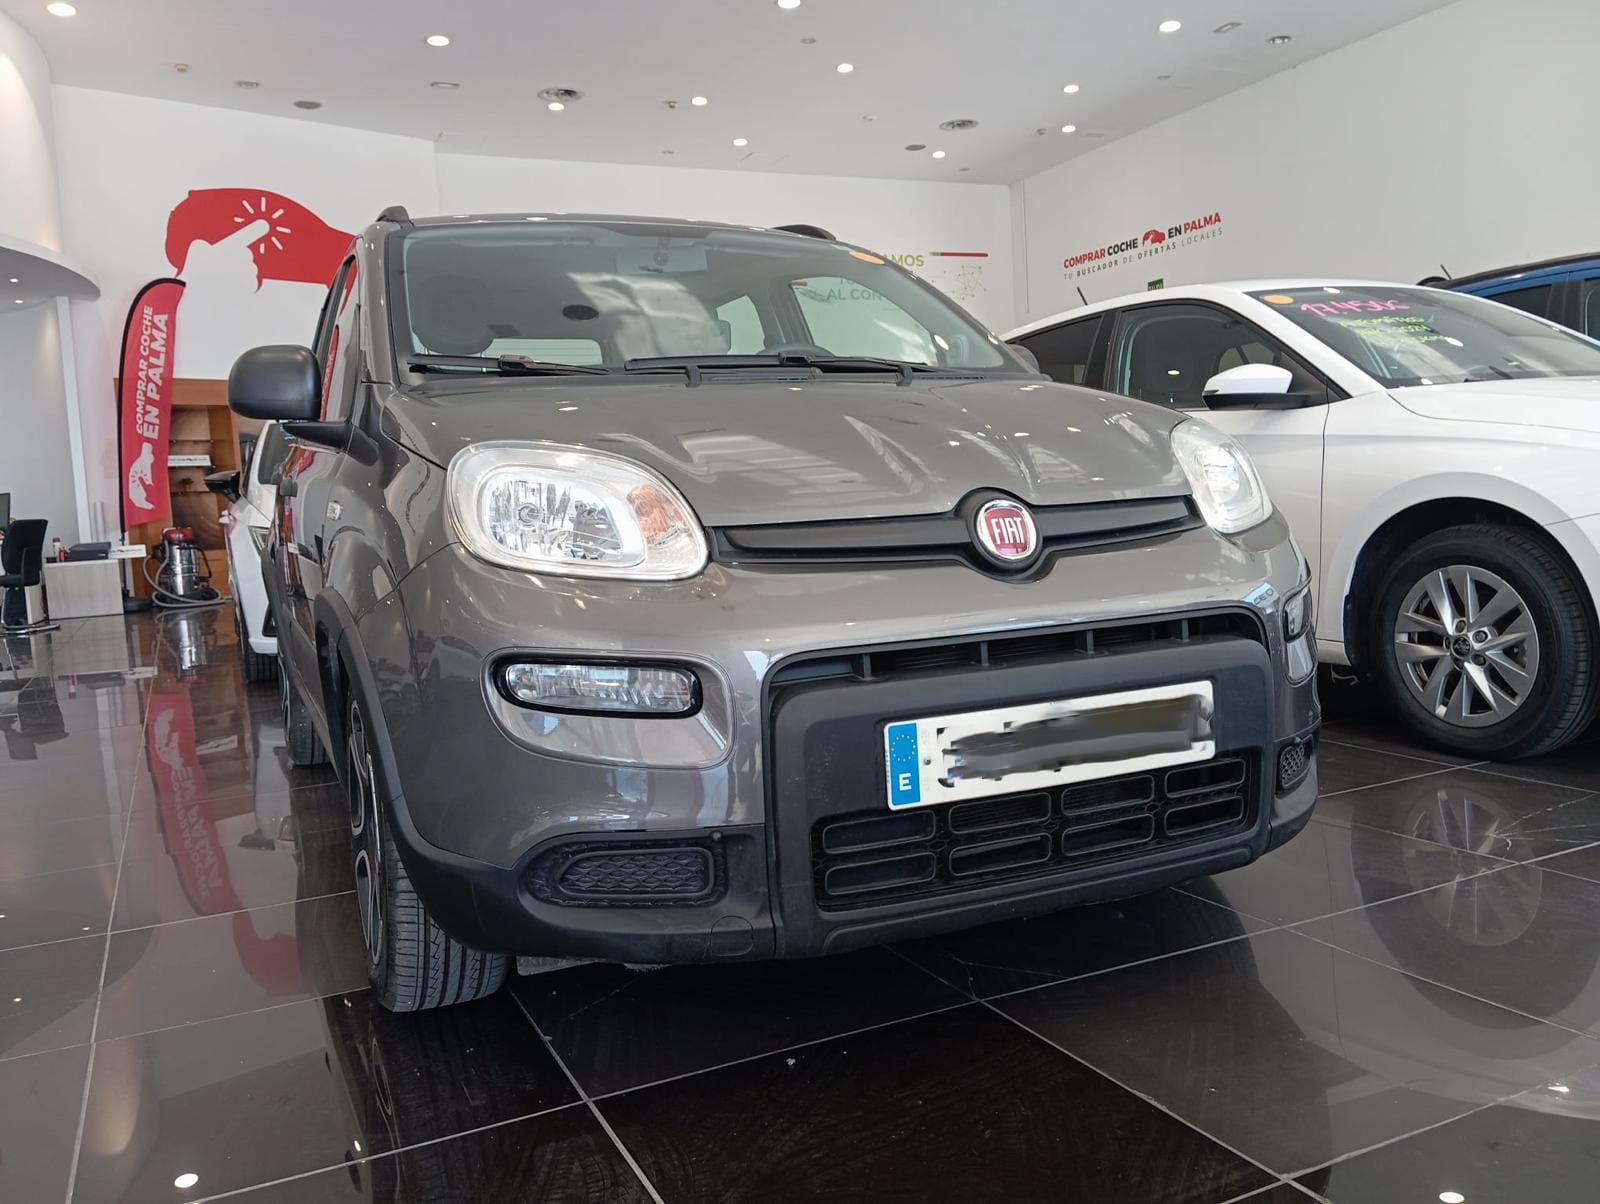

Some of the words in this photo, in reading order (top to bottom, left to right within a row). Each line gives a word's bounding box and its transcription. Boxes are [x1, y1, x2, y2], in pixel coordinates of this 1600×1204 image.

[1063, 248, 1106, 269] COMPRAR
[1107, 238, 1138, 256] COCHE
[1168, 225, 1182, 239] EN
[1183, 212, 1222, 234] PALMA
[1063, 272, 1073, 280] TU
[1076, 259, 1118, 277] BUSCADOR
[1122, 256, 1133, 264] DE
[1137, 242, 1177, 260] OFERTAS
[1181, 227, 1223, 248] LOCALES
[826, 288, 846, 301] AL
[140, 304, 153, 355] COCHE
[146, 313, 169, 401] PALMA
[136, 358, 149, 434] COMPRAR
[142, 405, 159, 440] EN
[990, 517, 1025, 545] FIAT
[898, 772, 912, 791] E
